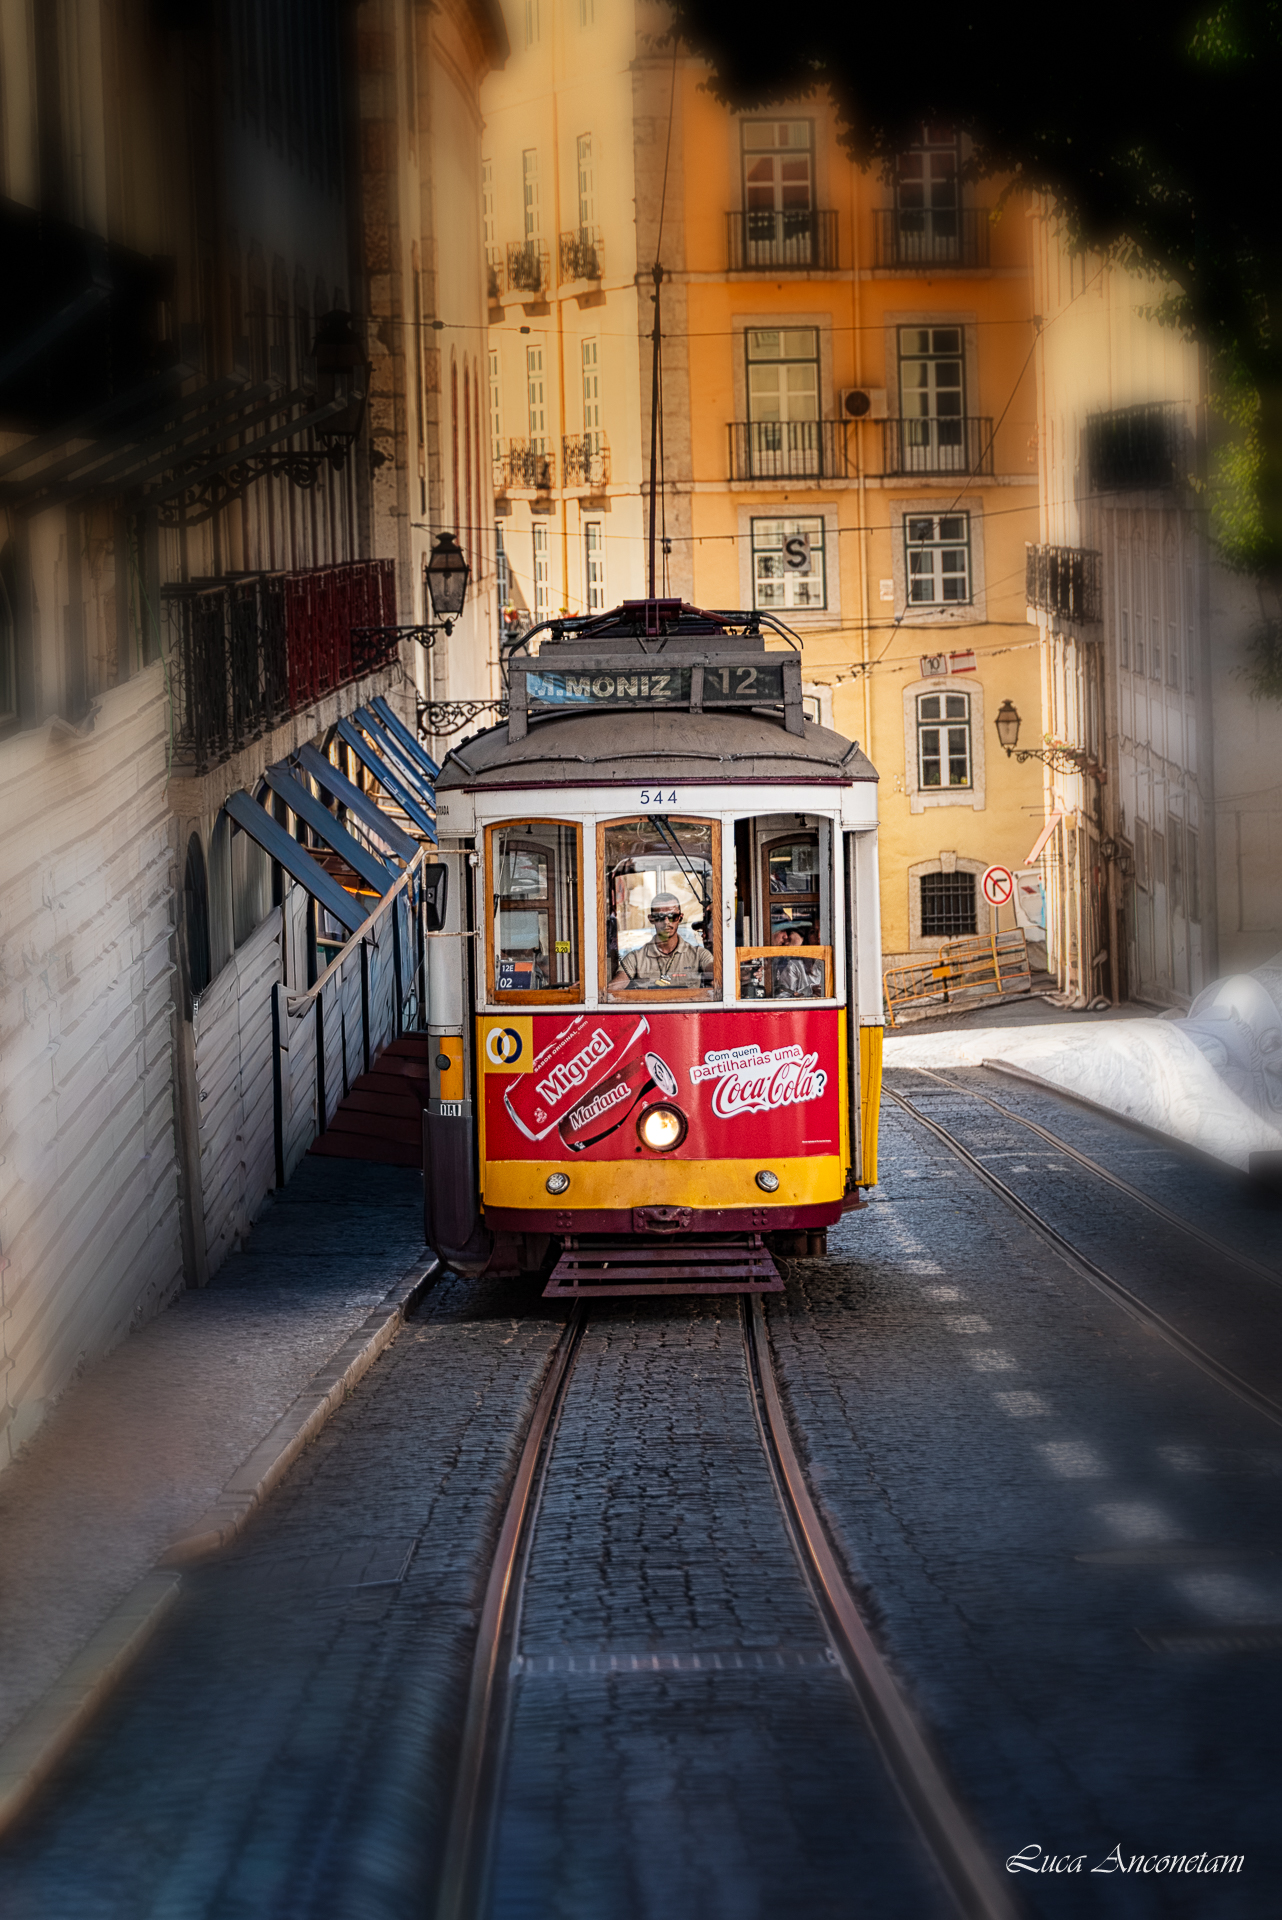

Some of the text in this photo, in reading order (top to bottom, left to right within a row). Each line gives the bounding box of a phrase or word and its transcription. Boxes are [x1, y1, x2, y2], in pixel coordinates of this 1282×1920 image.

[786, 538, 807, 568] S
[718, 667, 758, 694] 12
[640, 790, 677, 804] 544
[500, 978, 513, 988] 02
[534, 1054, 552, 1072] SABOR
[552, 1031, 577, 1054] ORIGINAL
[536, 1028, 614, 1105] Miguel
[692, 1047, 800, 1080] partilharias uma
[707, 1047, 758, 1062] Com quem
[569, 1083, 631, 1130] Mariana
